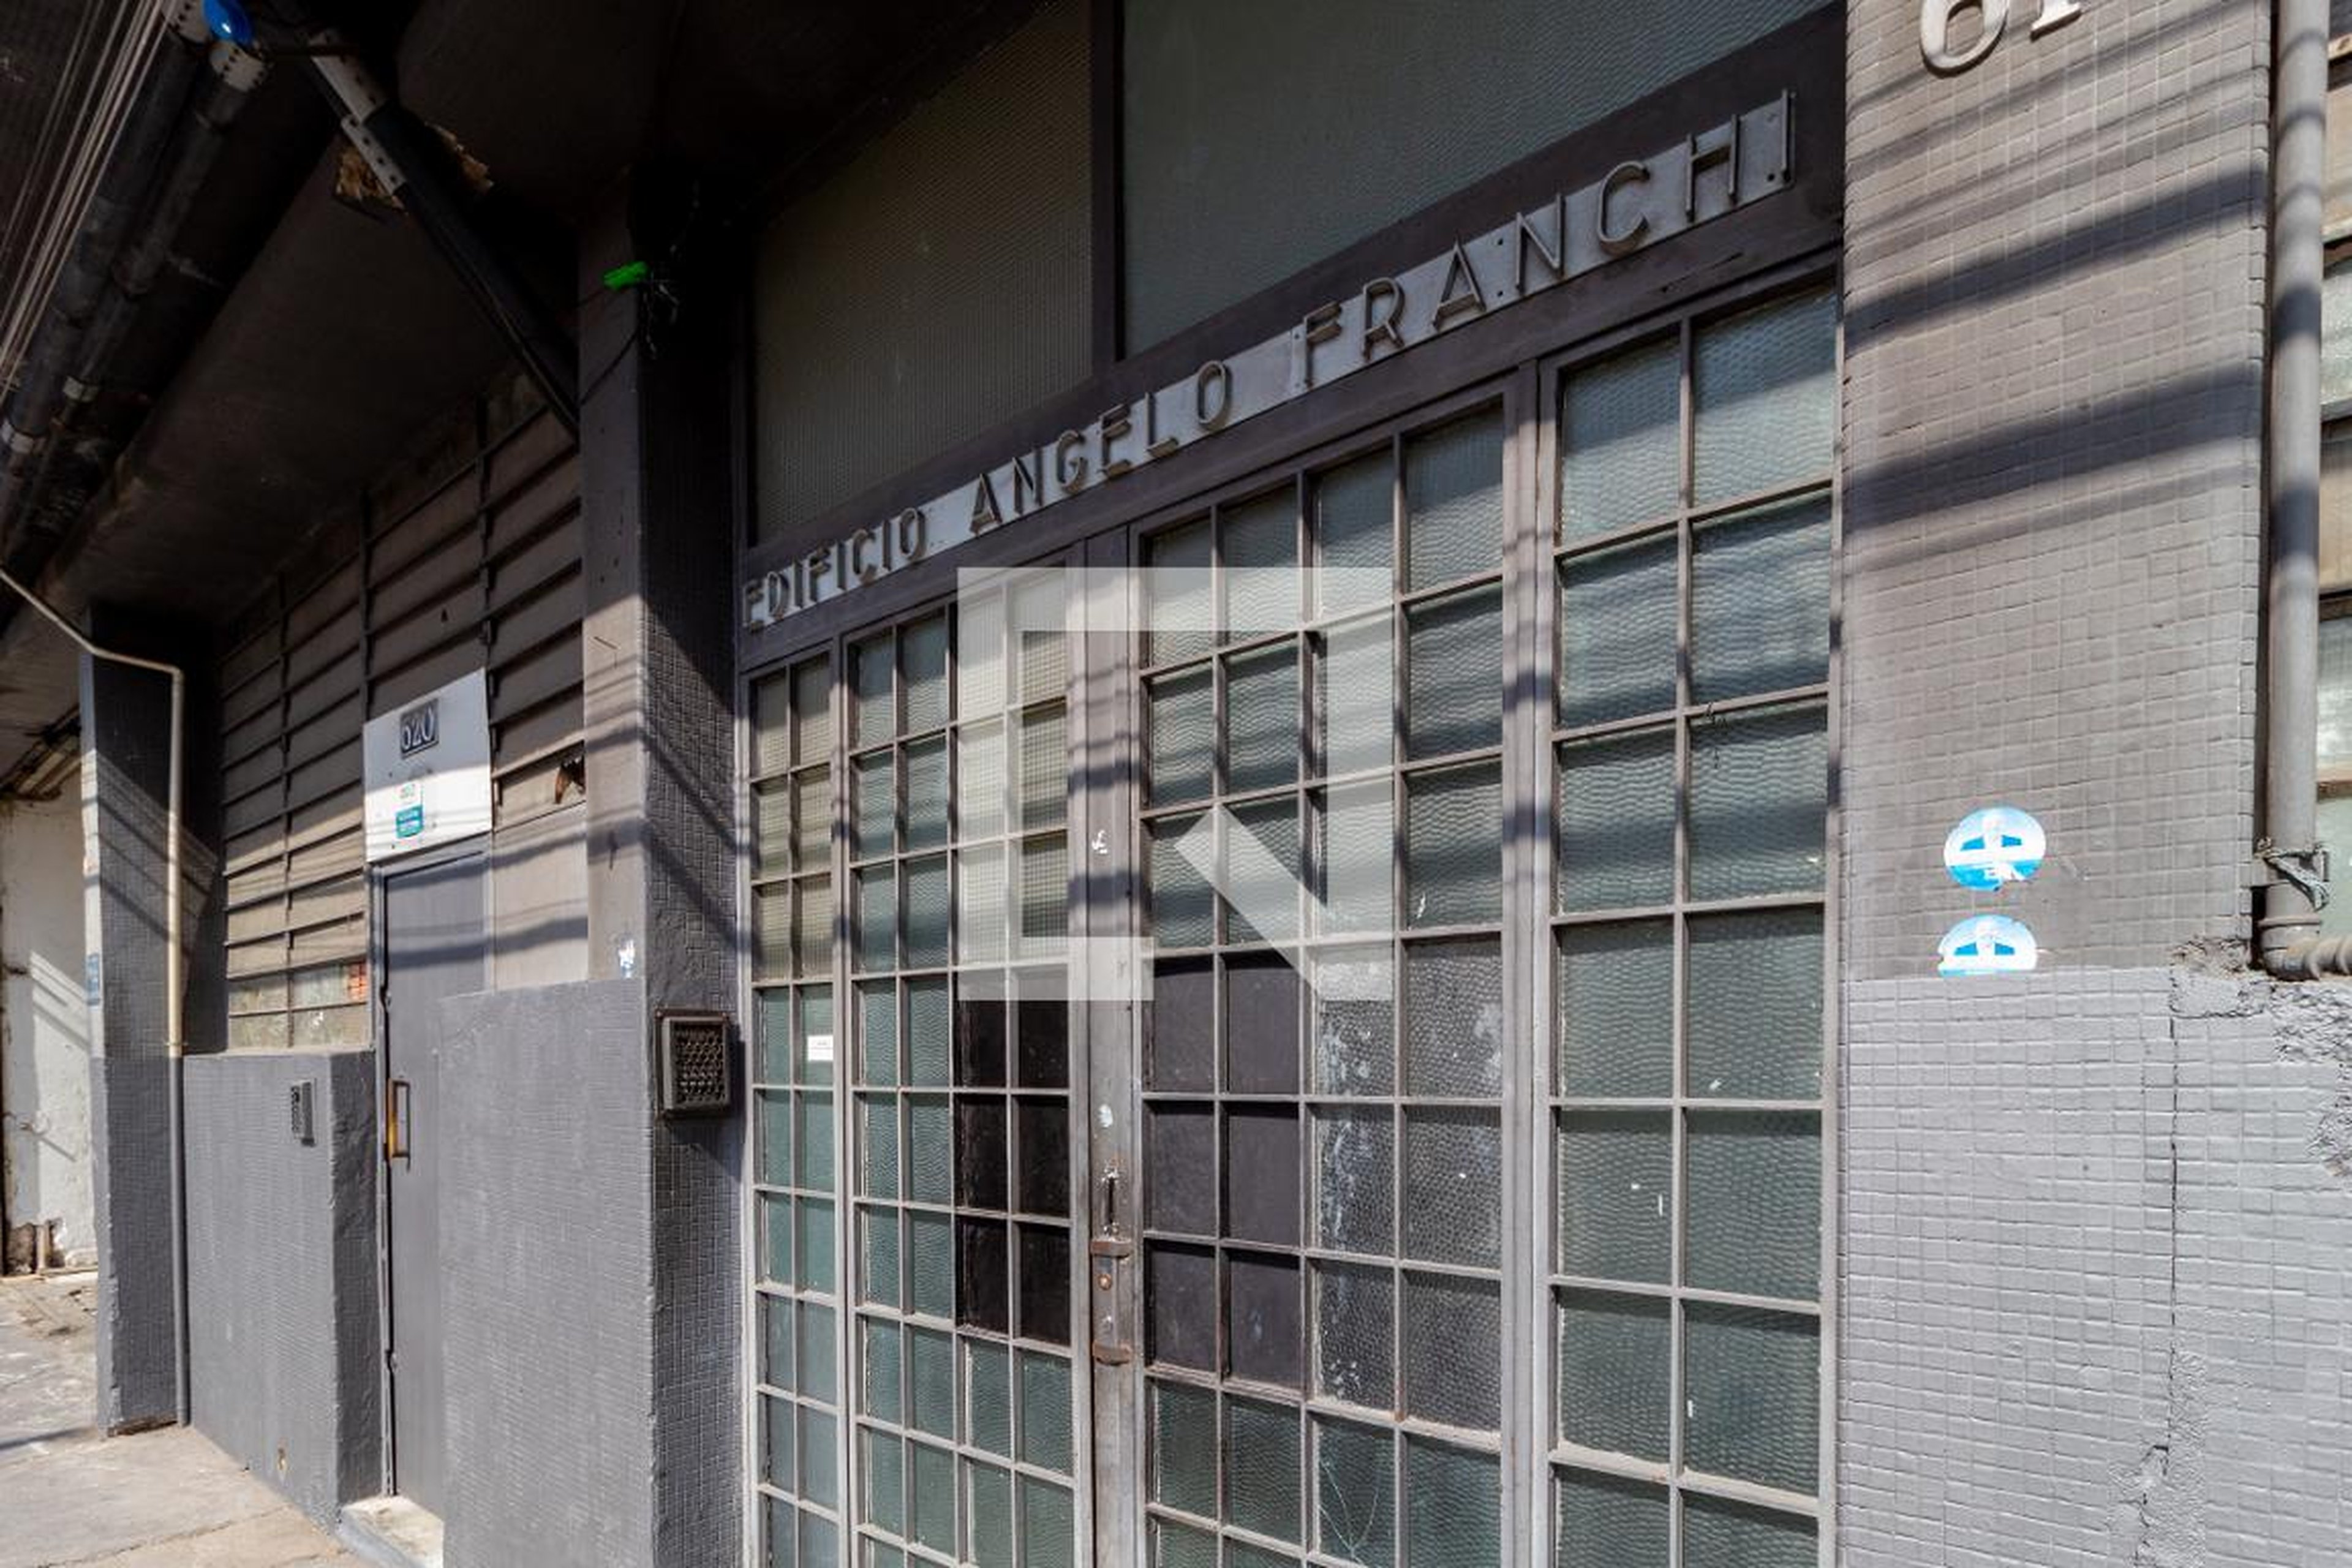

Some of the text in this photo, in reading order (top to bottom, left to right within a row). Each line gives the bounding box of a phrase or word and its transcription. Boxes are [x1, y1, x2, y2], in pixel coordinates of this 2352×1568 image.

[742, 88, 1795, 632] EDIFICIO ANGELO FRANCHI
